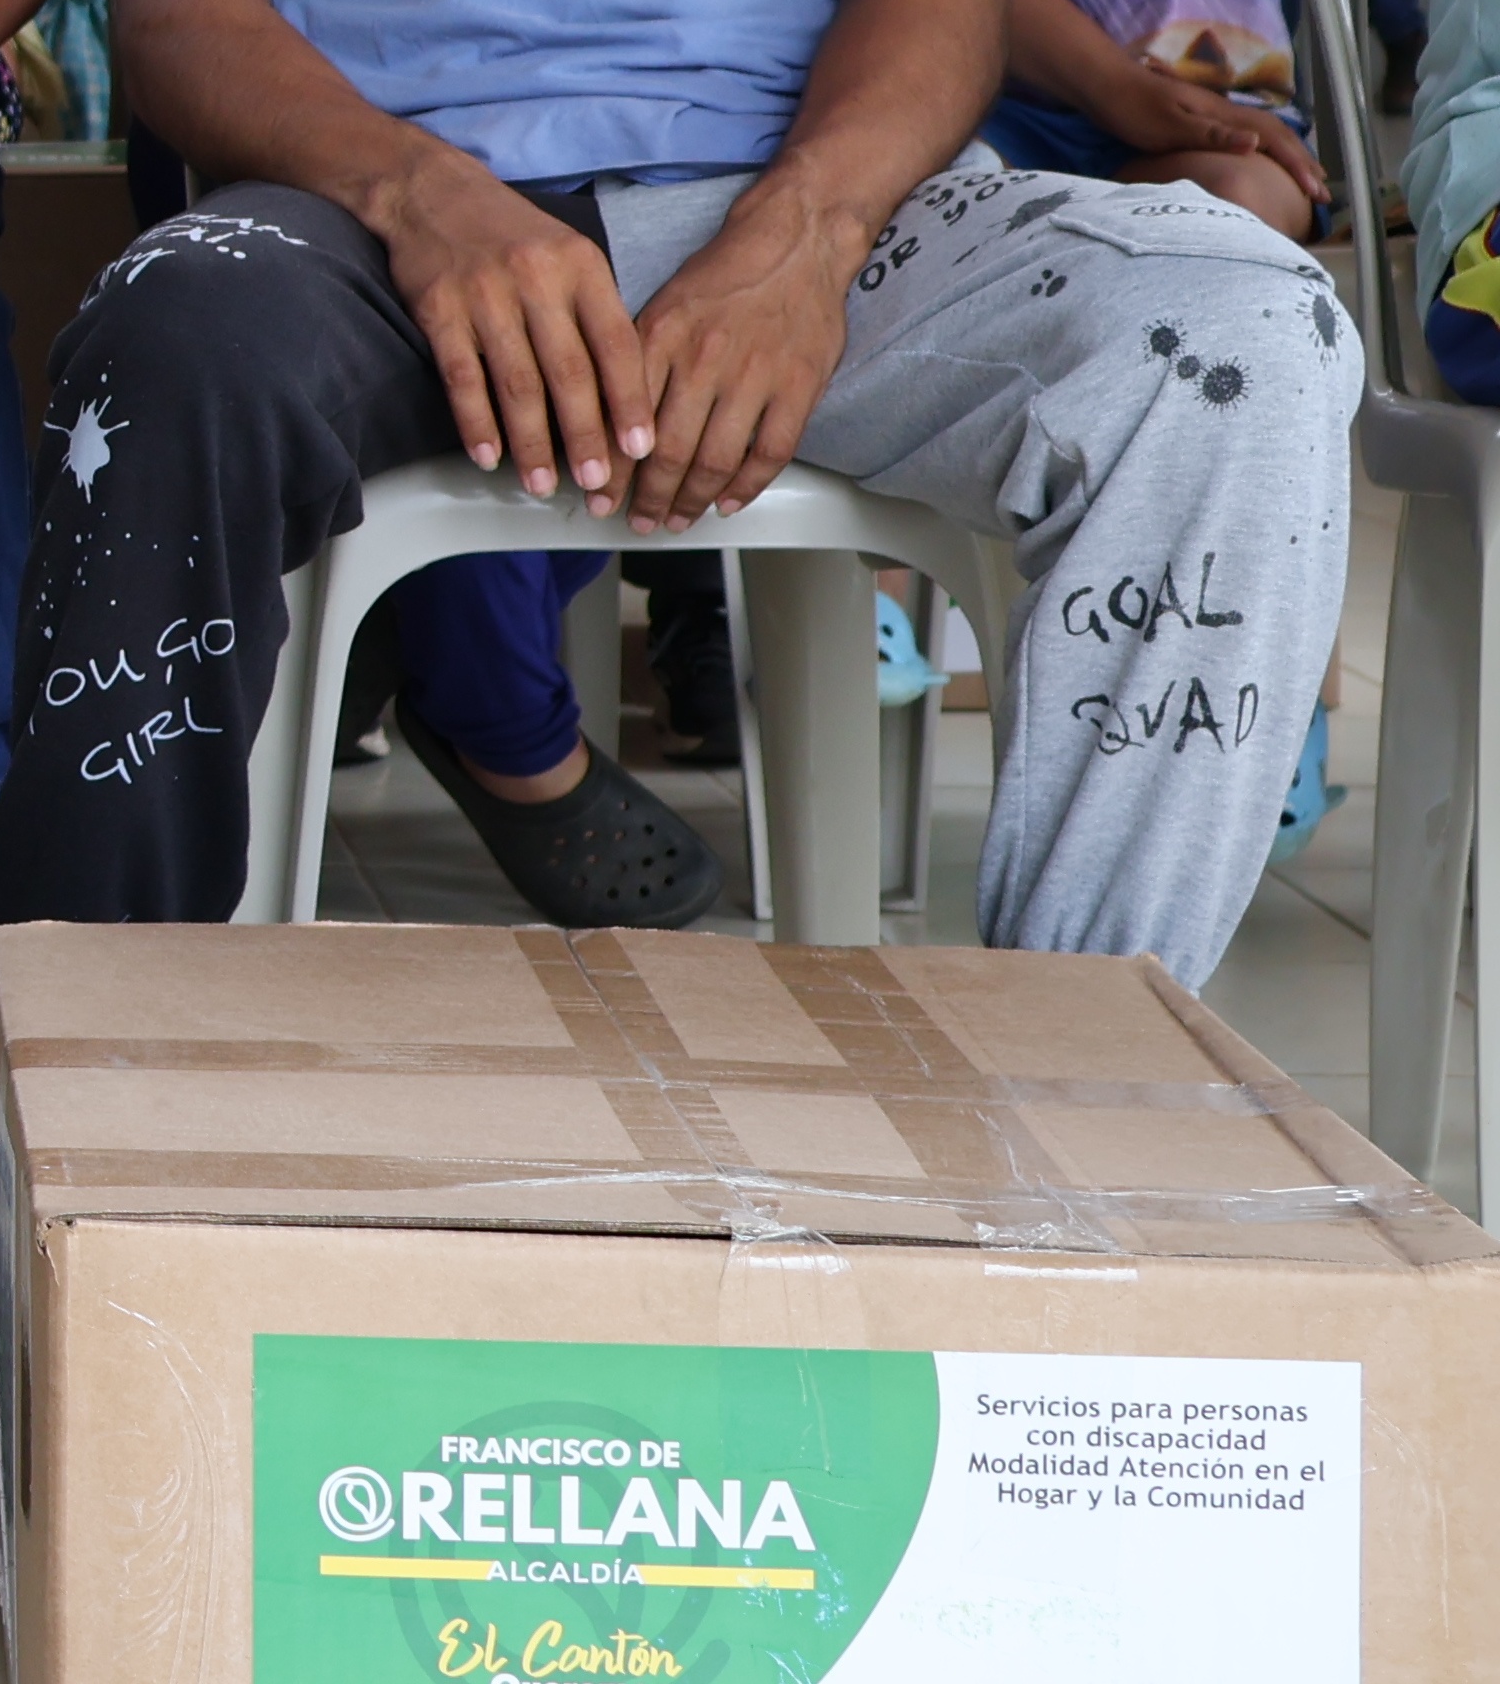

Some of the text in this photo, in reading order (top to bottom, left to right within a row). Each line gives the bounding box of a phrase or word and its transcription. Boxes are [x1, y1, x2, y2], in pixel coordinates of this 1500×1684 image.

[1062, 551, 1244, 643] GOAL
[80, 695, 224, 784] GIRL
[977, 1394, 1308, 1425] Servicios para personas
[441, 1436, 680, 1468] FRANCISCO DE
[1026, 1426, 1267, 1454] con discapacidad
[968, 1453, 1325, 1482] Modalidad Atención en el
[319, 1466, 816, 1551] ORELLANA
[998, 1483, 1305, 1511] Hogar y la Comunidad
[485, 1559, 645, 1585] ALCALDÍA
[437, 1618, 682, 1679] El Cantón
